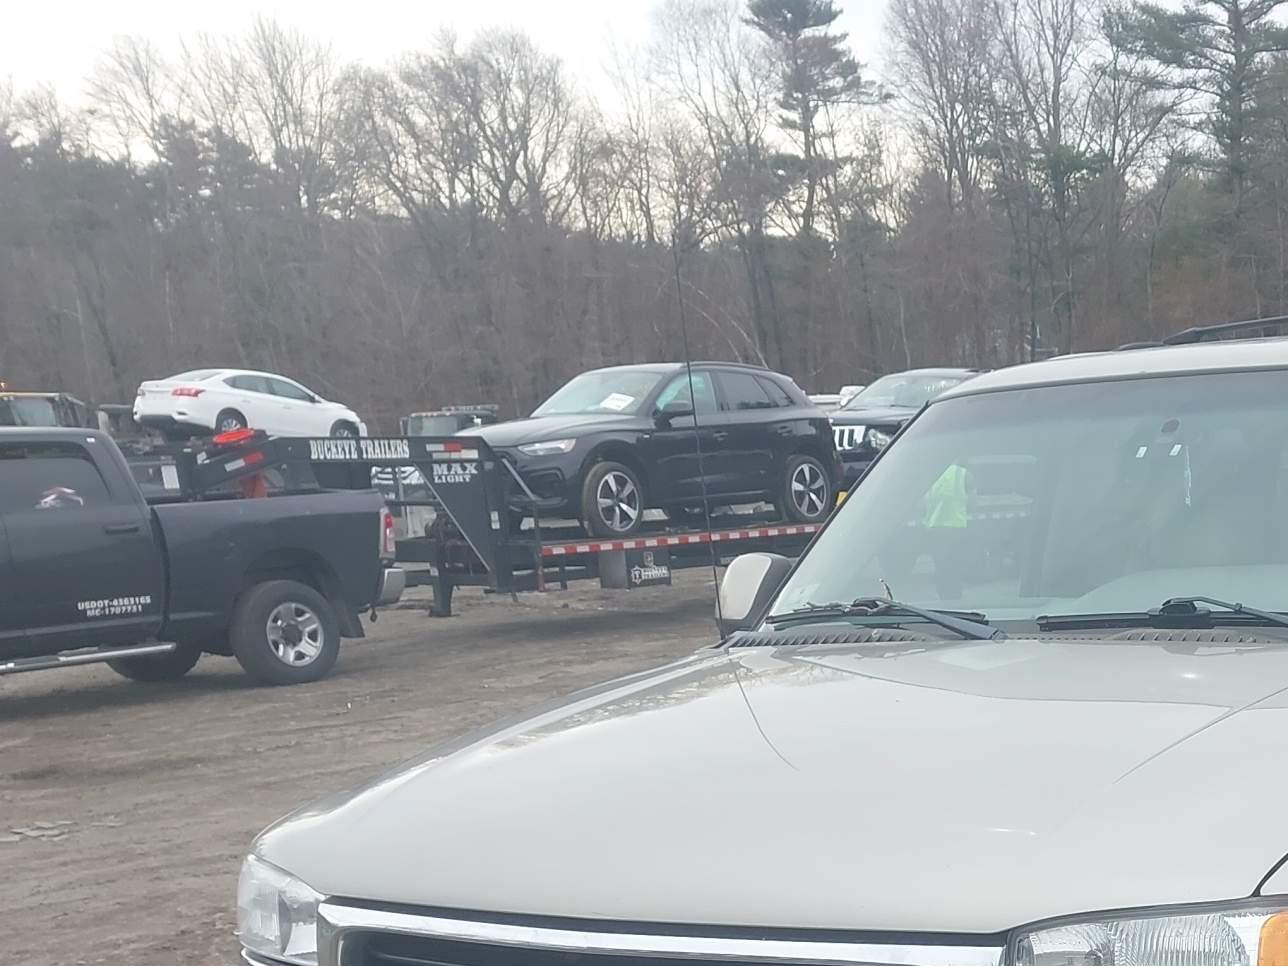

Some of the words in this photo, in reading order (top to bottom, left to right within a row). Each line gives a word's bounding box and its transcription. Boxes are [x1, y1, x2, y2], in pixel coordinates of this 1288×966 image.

[309, 439, 358, 460] BUCKEYE
[360, 439, 410, 459] TRAILERS
[432, 462, 478, 475] MAX
[434, 475, 472, 484] LIGHT
